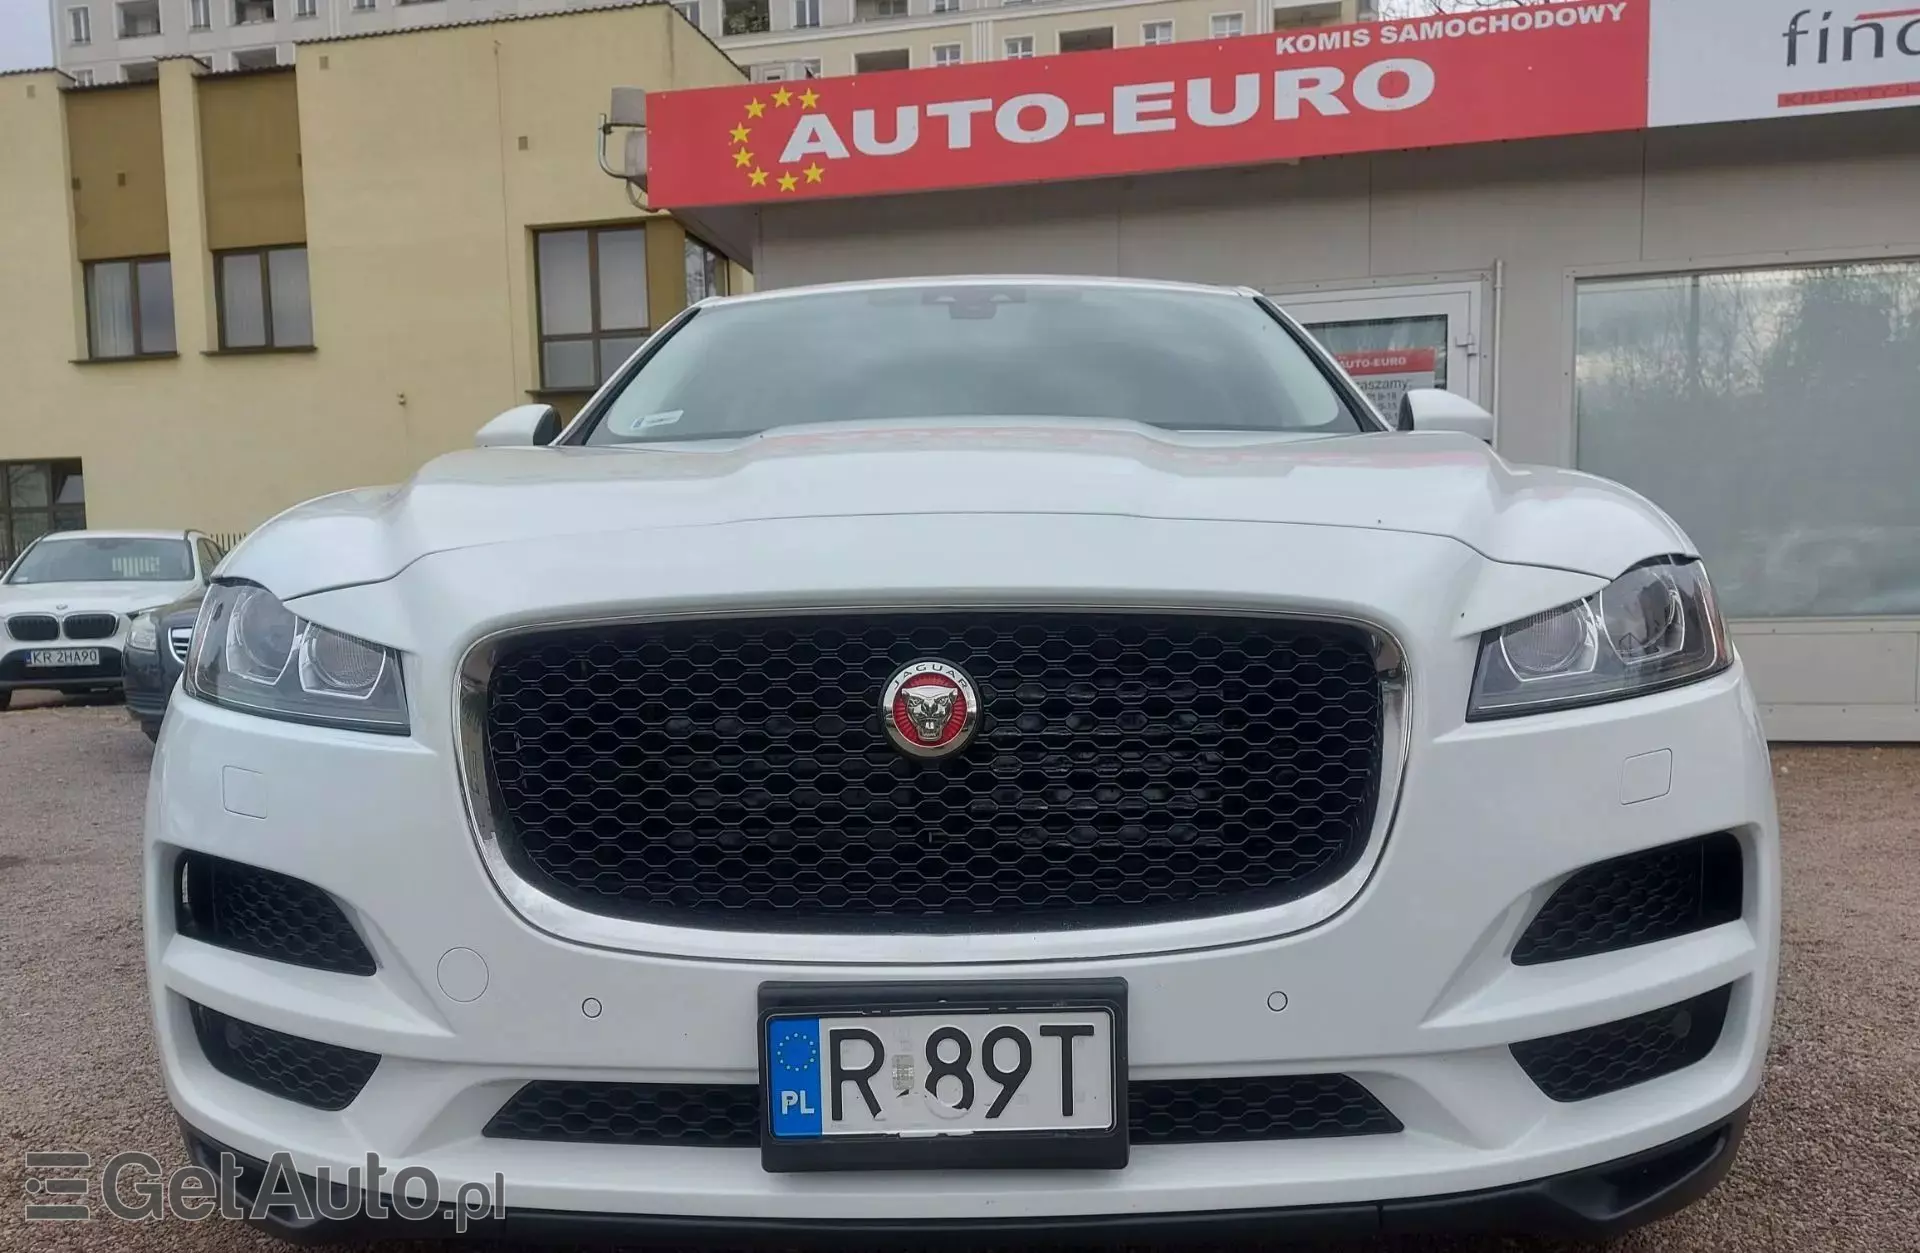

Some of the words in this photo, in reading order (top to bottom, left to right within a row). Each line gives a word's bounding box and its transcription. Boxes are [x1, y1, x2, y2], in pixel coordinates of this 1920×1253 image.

[1275, 29, 1371, 56] KOMIS
[1380, 2, 1628, 44] SAMOCHODOWY
[778, 57, 1436, 164] AUTO-EURO
[33, 650, 52, 663] KR
[56, 649, 97, 663] 2HA90
[894, 663, 969, 690] JAGUAR
[780, 1090, 815, 1115] PL
